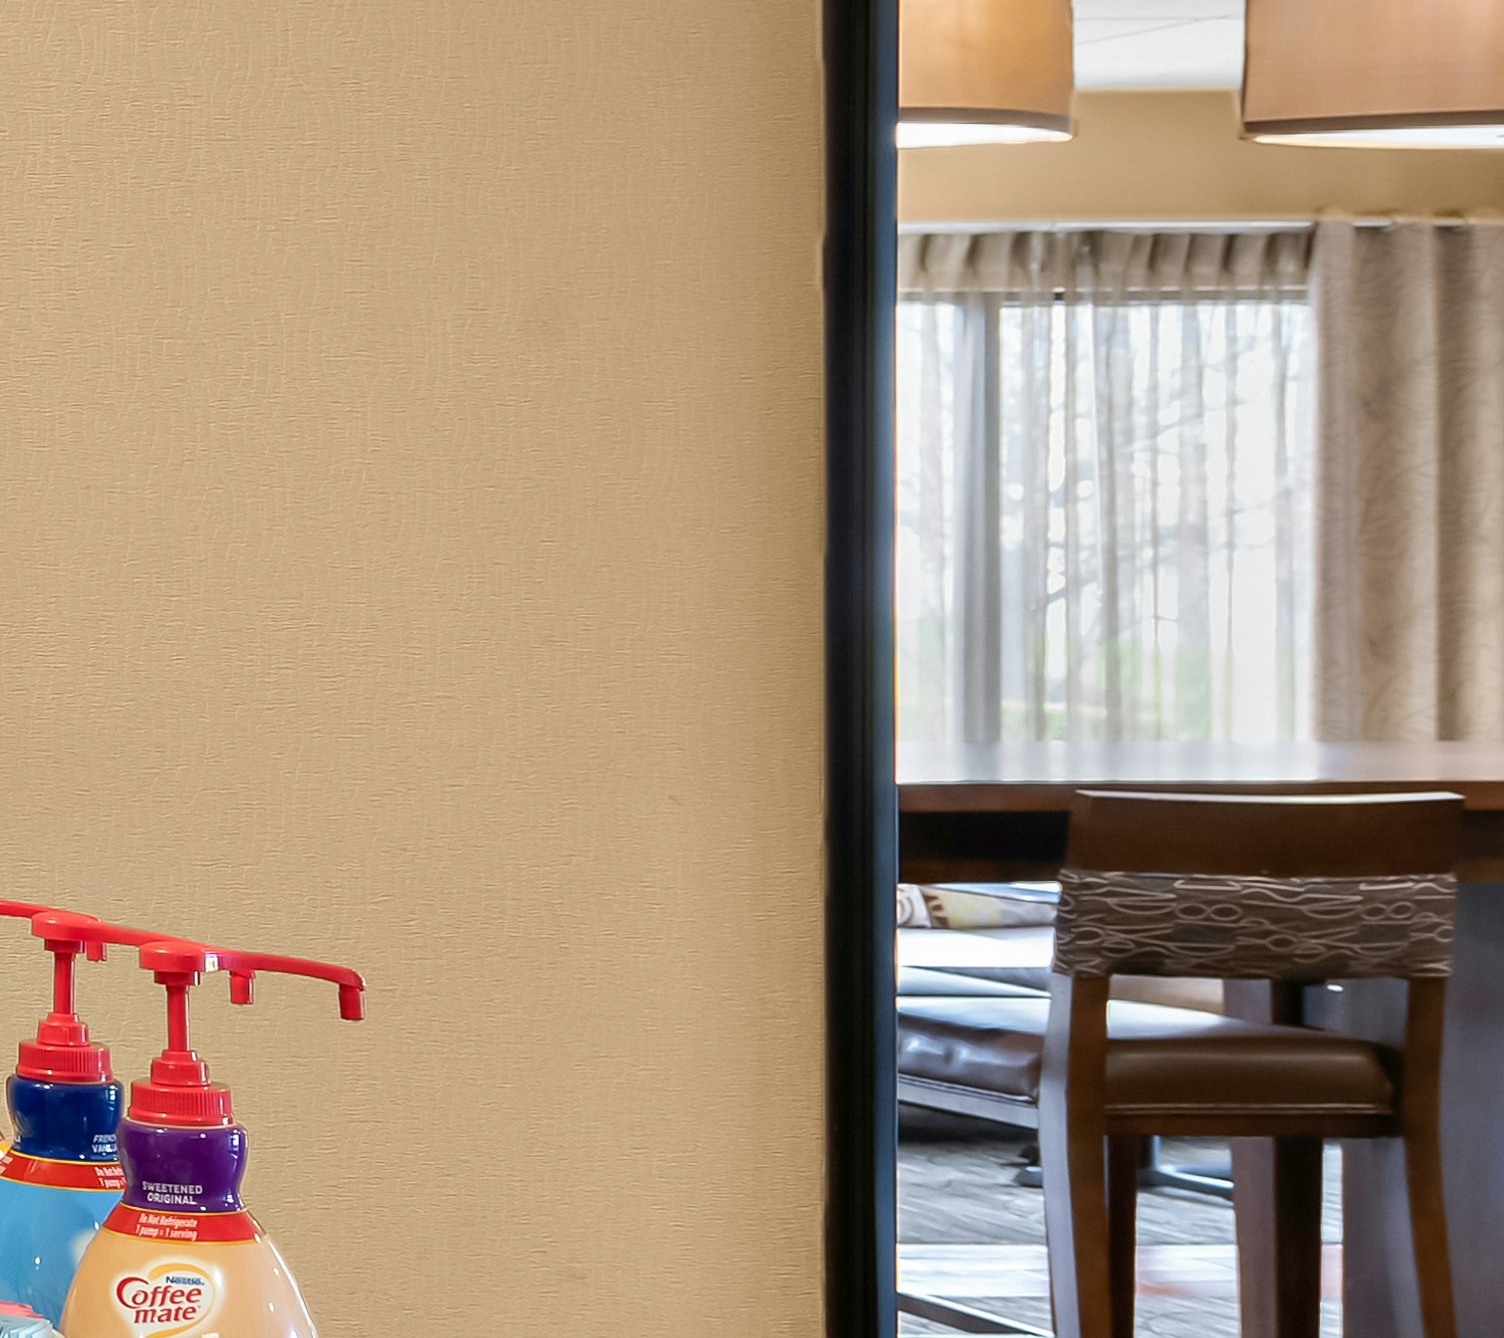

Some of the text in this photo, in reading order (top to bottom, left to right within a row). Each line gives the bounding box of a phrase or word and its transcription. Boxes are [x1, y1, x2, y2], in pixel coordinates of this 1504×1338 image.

[142, 1181, 203, 1194] SWEETENED
[147, 1192, 196, 1205] ORIGINAL
[139, 1213, 198, 1229] Do Not Refrigerate
[136, 1224, 141, 1233] 1
[139, 1226, 159, 1237] pump
[165, 1227, 170, 1237] 1
[170, 1229, 198, 1241] serving
[116, 1276, 202, 1309] Coffee
[134, 1304, 197, 1324] mate
